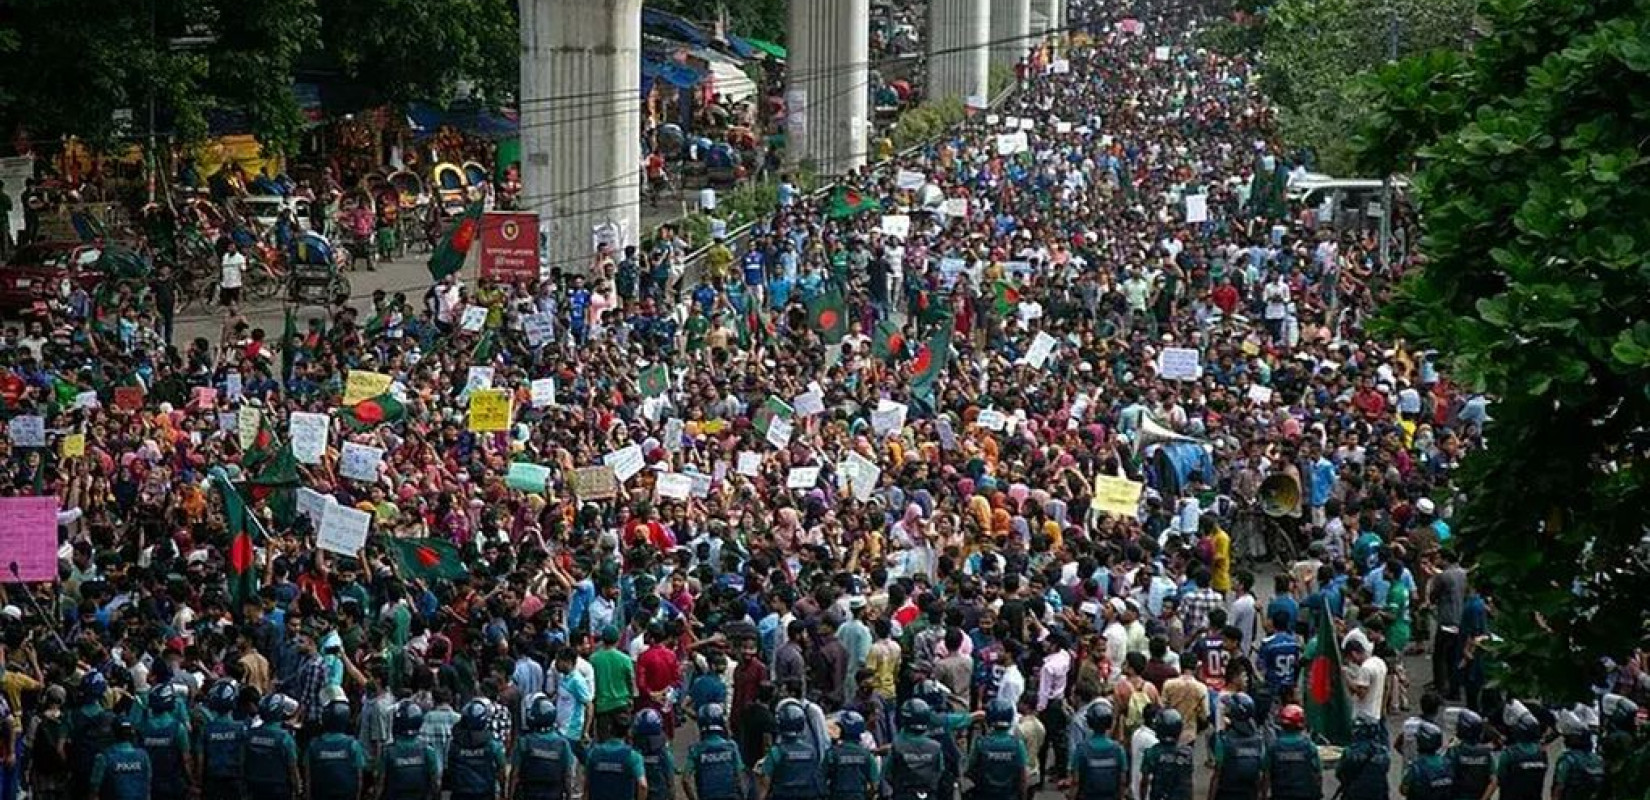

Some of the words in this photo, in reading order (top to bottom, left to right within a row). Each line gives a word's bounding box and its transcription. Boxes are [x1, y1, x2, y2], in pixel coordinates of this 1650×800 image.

[701, 751, 732, 763] POLICE
[903, 753, 933, 762] POLICE
[116, 761, 141, 771] POLICE
